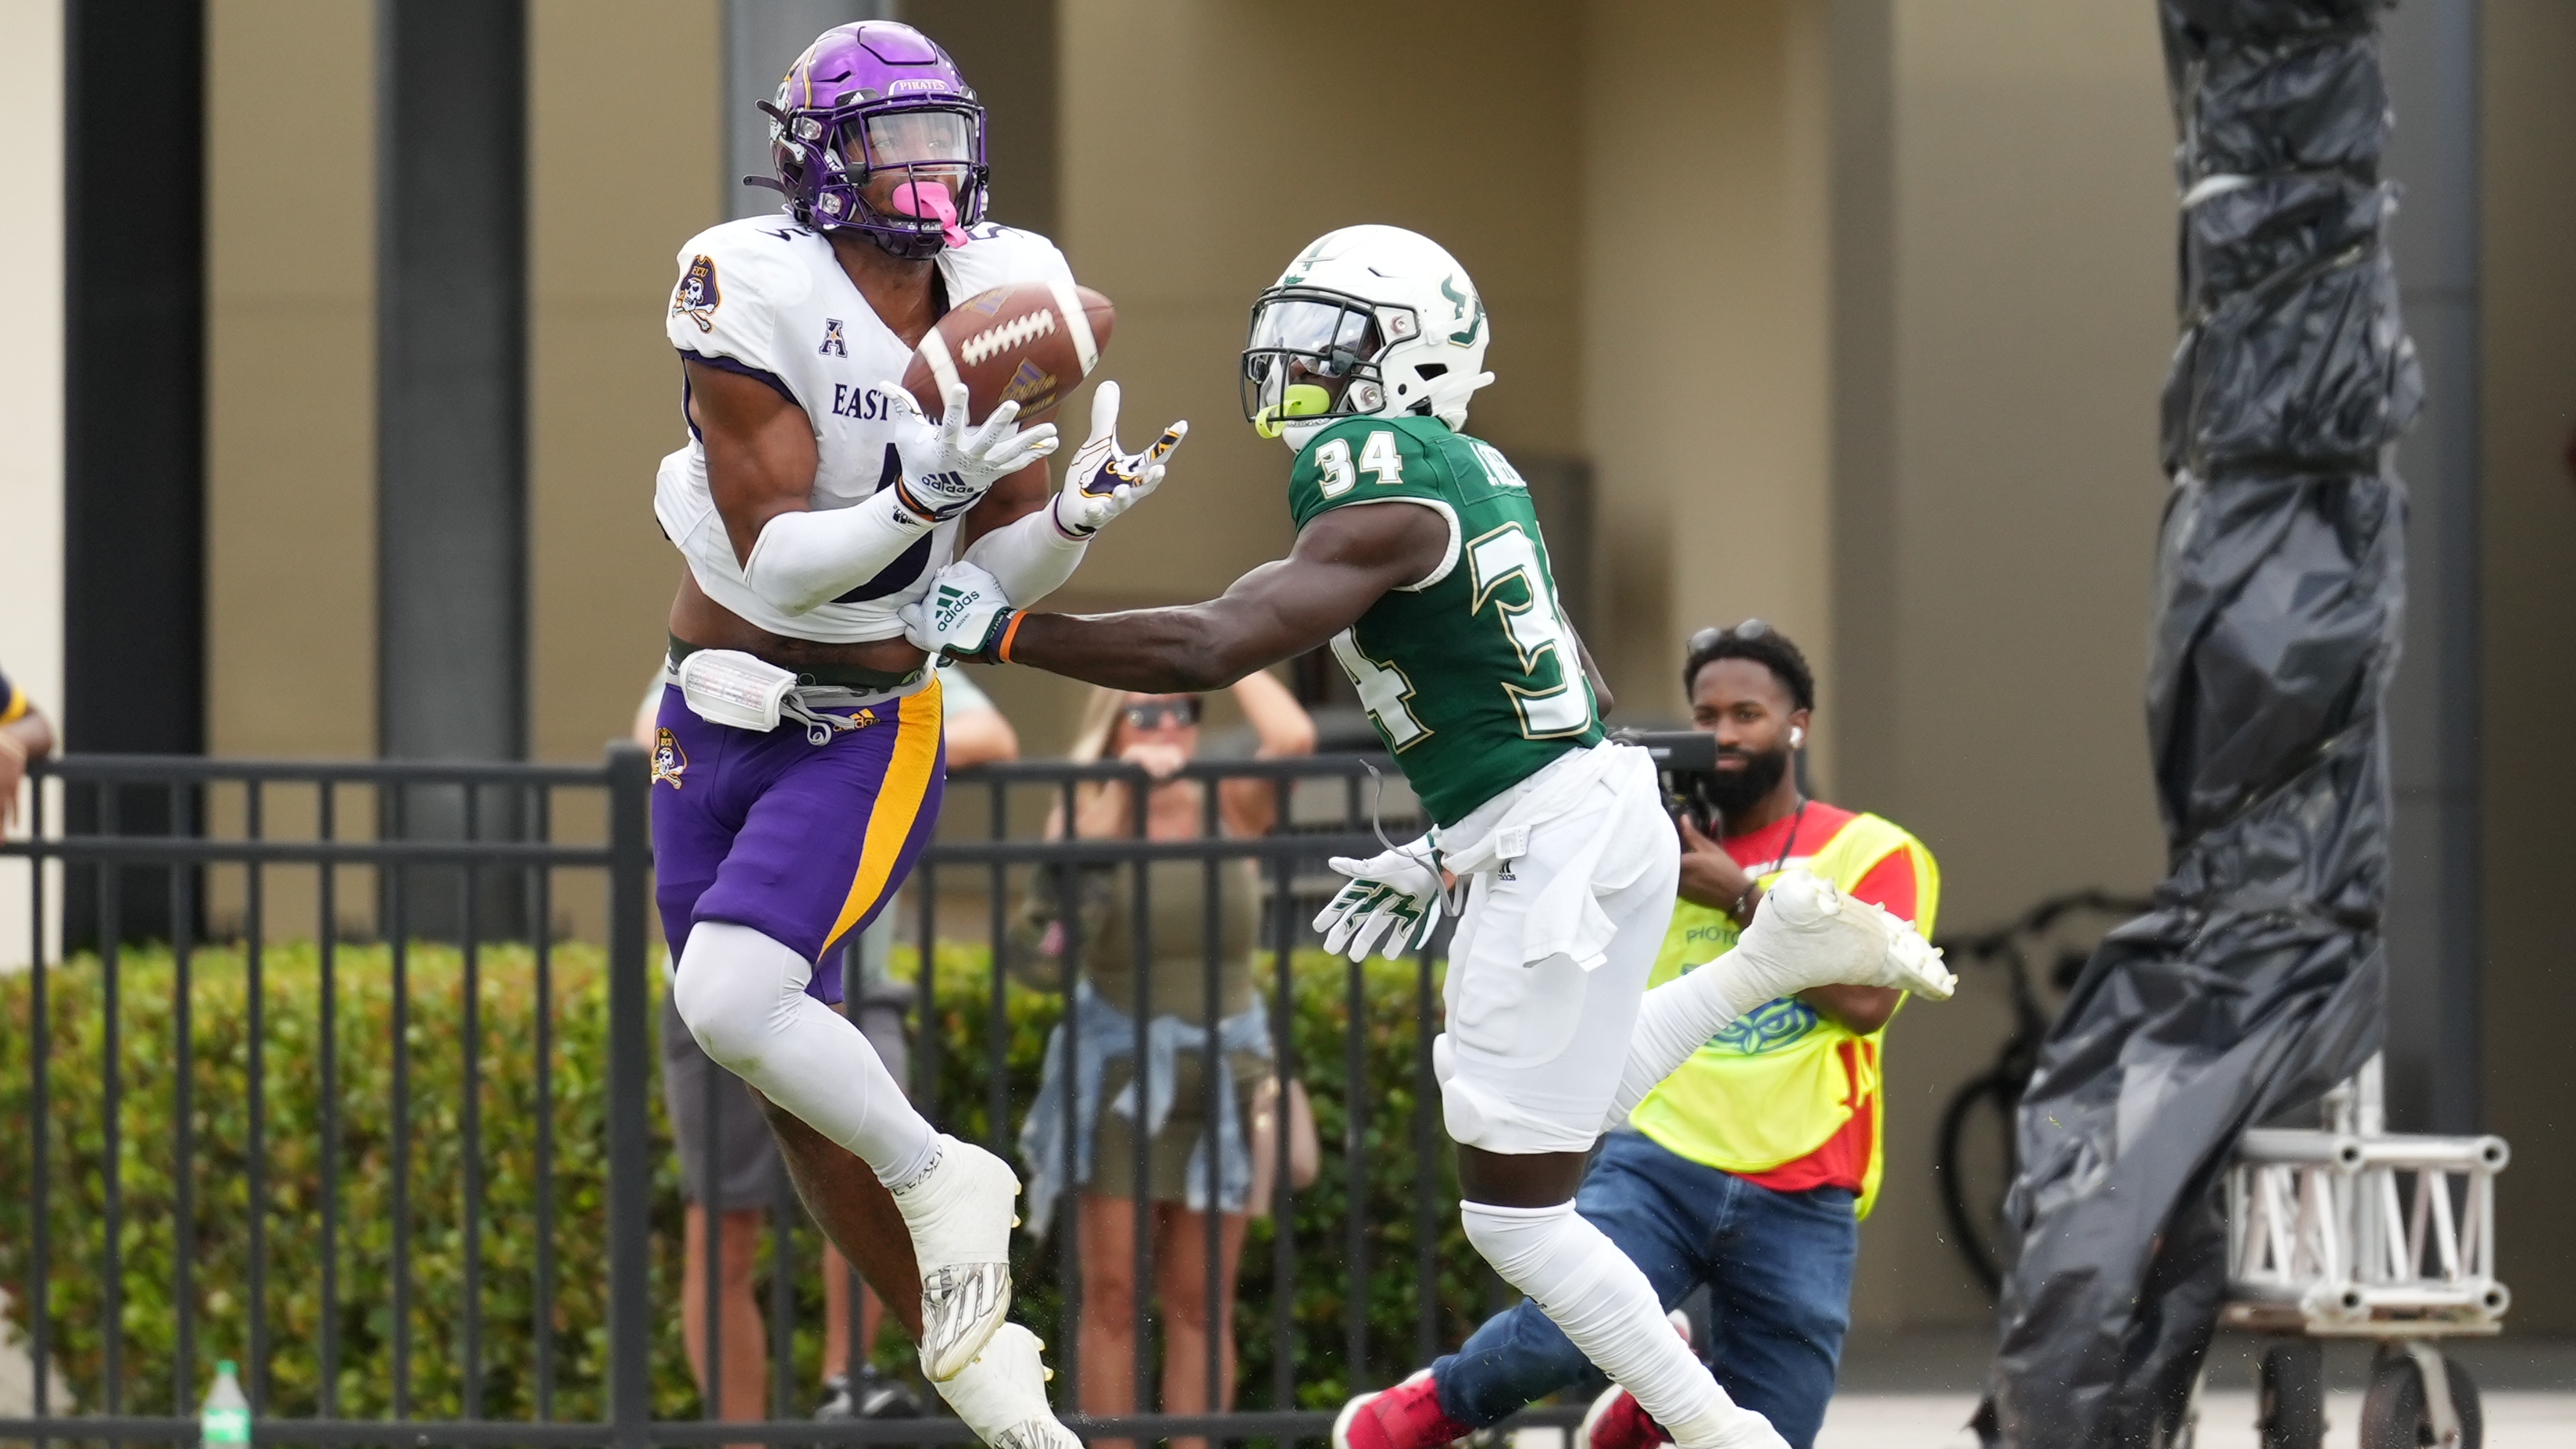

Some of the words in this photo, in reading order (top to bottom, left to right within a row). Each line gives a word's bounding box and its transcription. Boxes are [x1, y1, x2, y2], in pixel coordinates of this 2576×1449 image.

[899, 81, 945, 91] PIRATES
[692, 265, 709, 277] ECU
[831, 383, 888, 421] EAST
[1314, 430, 1404, 500] 34
[921, 476, 974, 494] adidas
[938, 591, 981, 632] adidas
